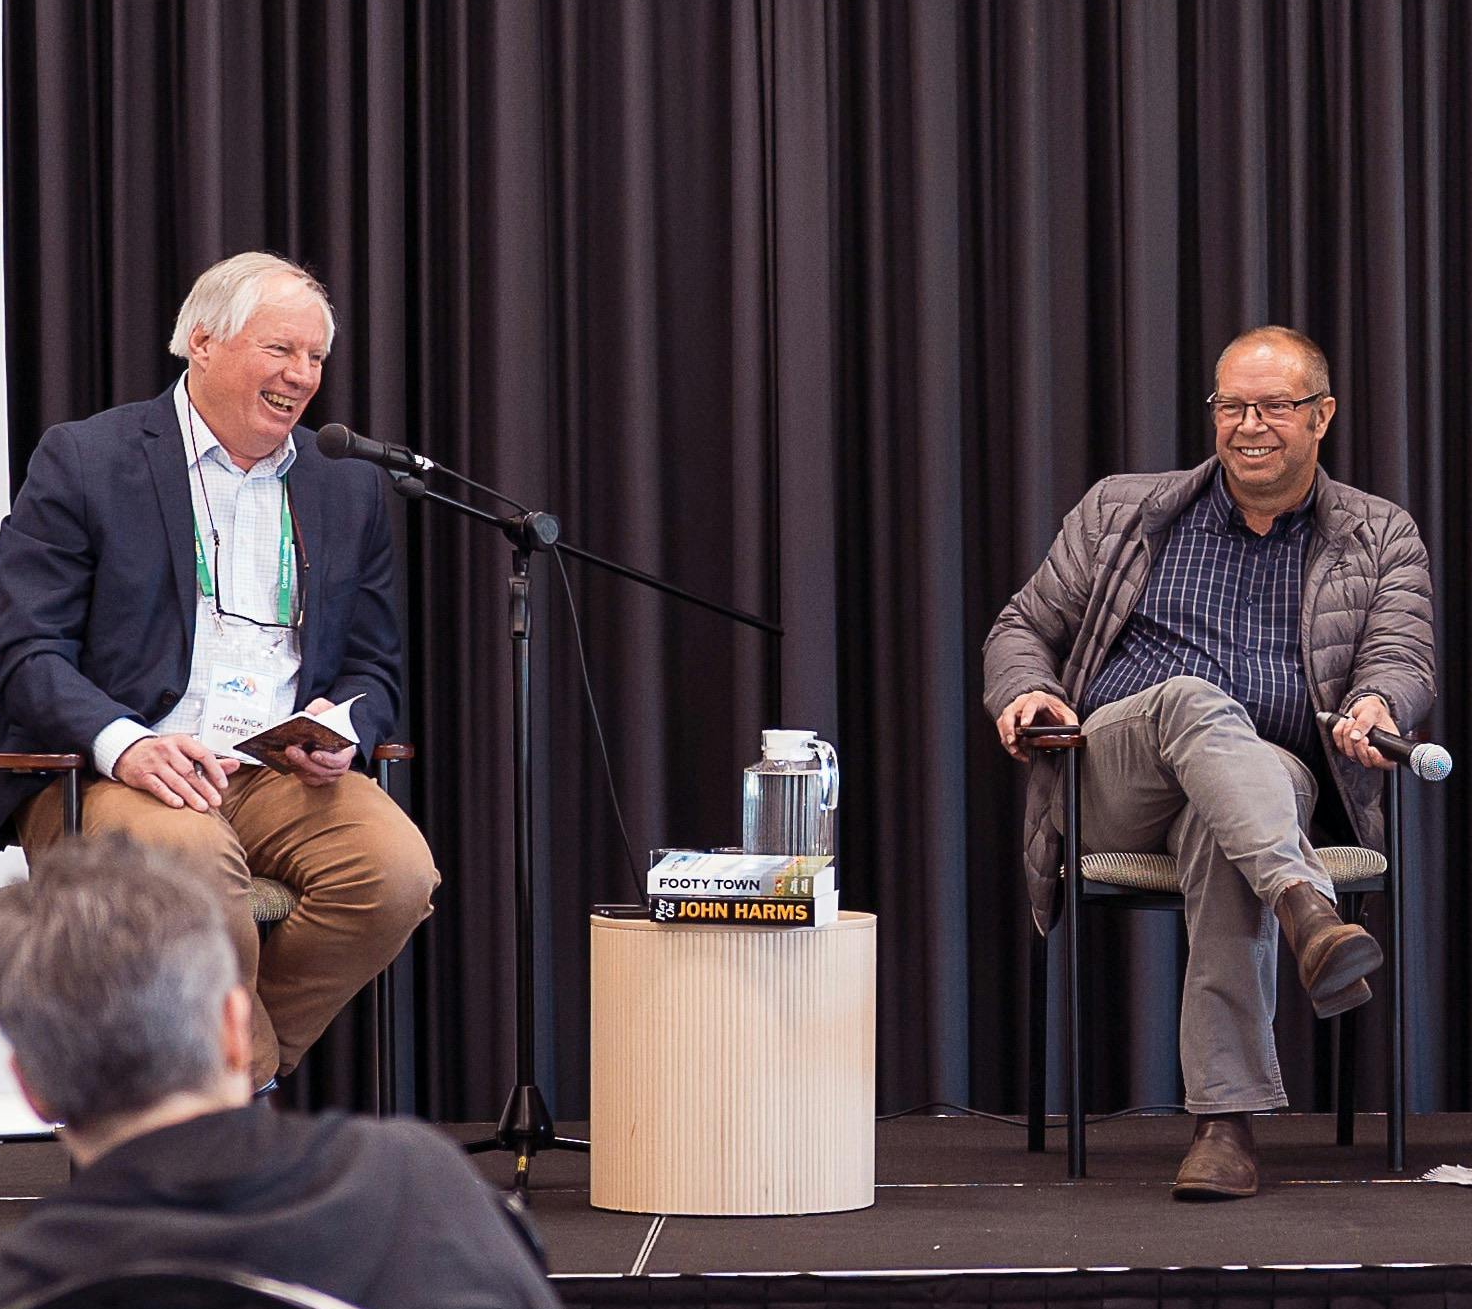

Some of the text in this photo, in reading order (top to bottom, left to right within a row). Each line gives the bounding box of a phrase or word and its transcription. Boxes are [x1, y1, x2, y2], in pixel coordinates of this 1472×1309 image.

[659, 878, 761, 891] FOOTY TOWN
[655, 898, 669, 921] Play
[665, 902, 675, 918] On
[678, 901, 808, 921] JOHN HARMS
